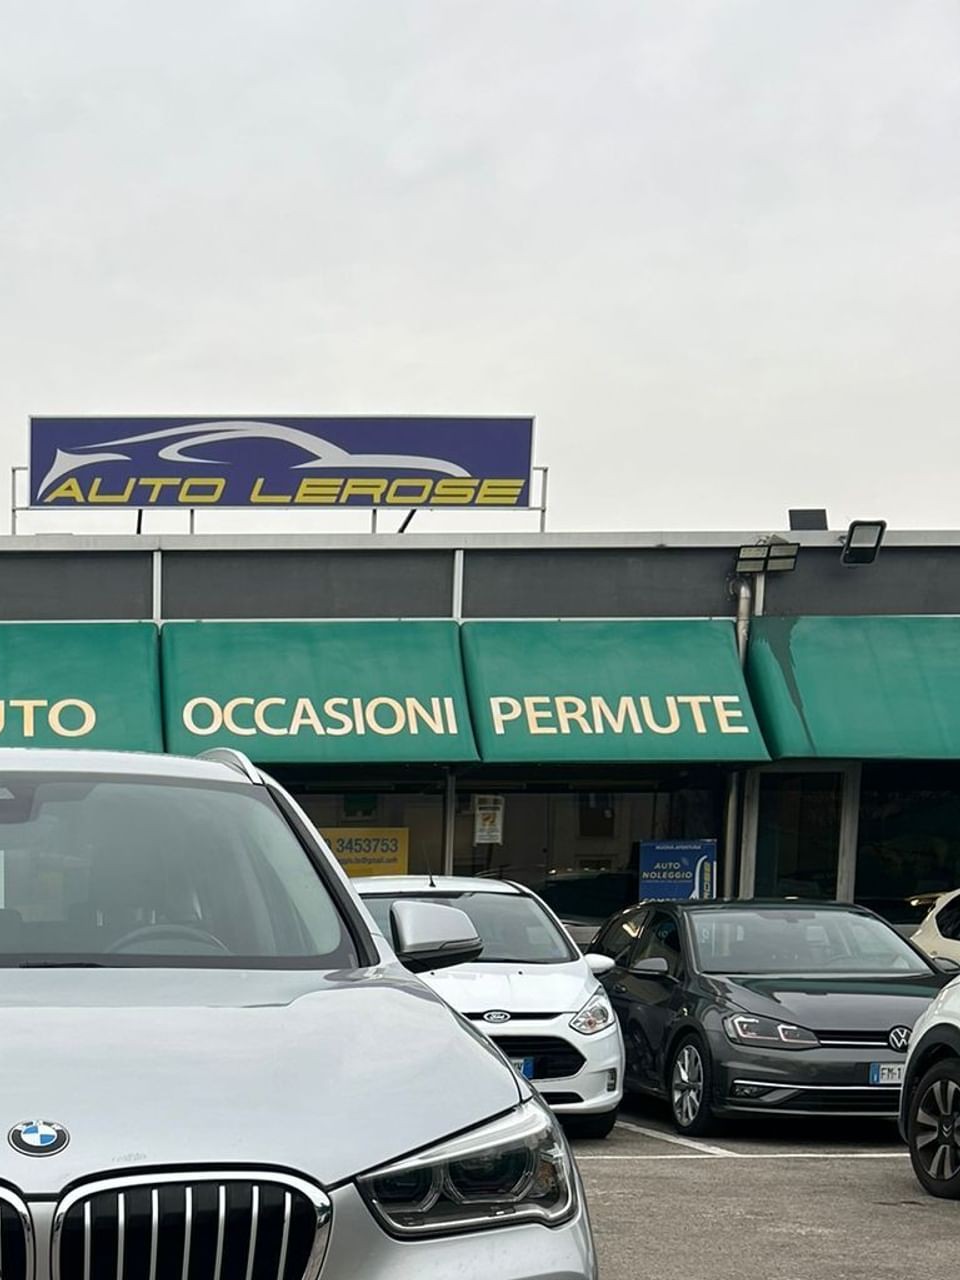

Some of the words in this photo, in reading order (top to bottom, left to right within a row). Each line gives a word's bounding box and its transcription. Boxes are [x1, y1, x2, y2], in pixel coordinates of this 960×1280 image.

[43, 477, 226, 503] AUTO
[250, 477, 526, 505] LEROSE
[182, 696, 458, 736] OCCASIONI
[489, 695, 750, 735] PERMUTE
[336, 838, 399, 853] 3453753
[654, 862, 681, 870] AUTO
[642, 871, 693, 879] NOLEGGIO
